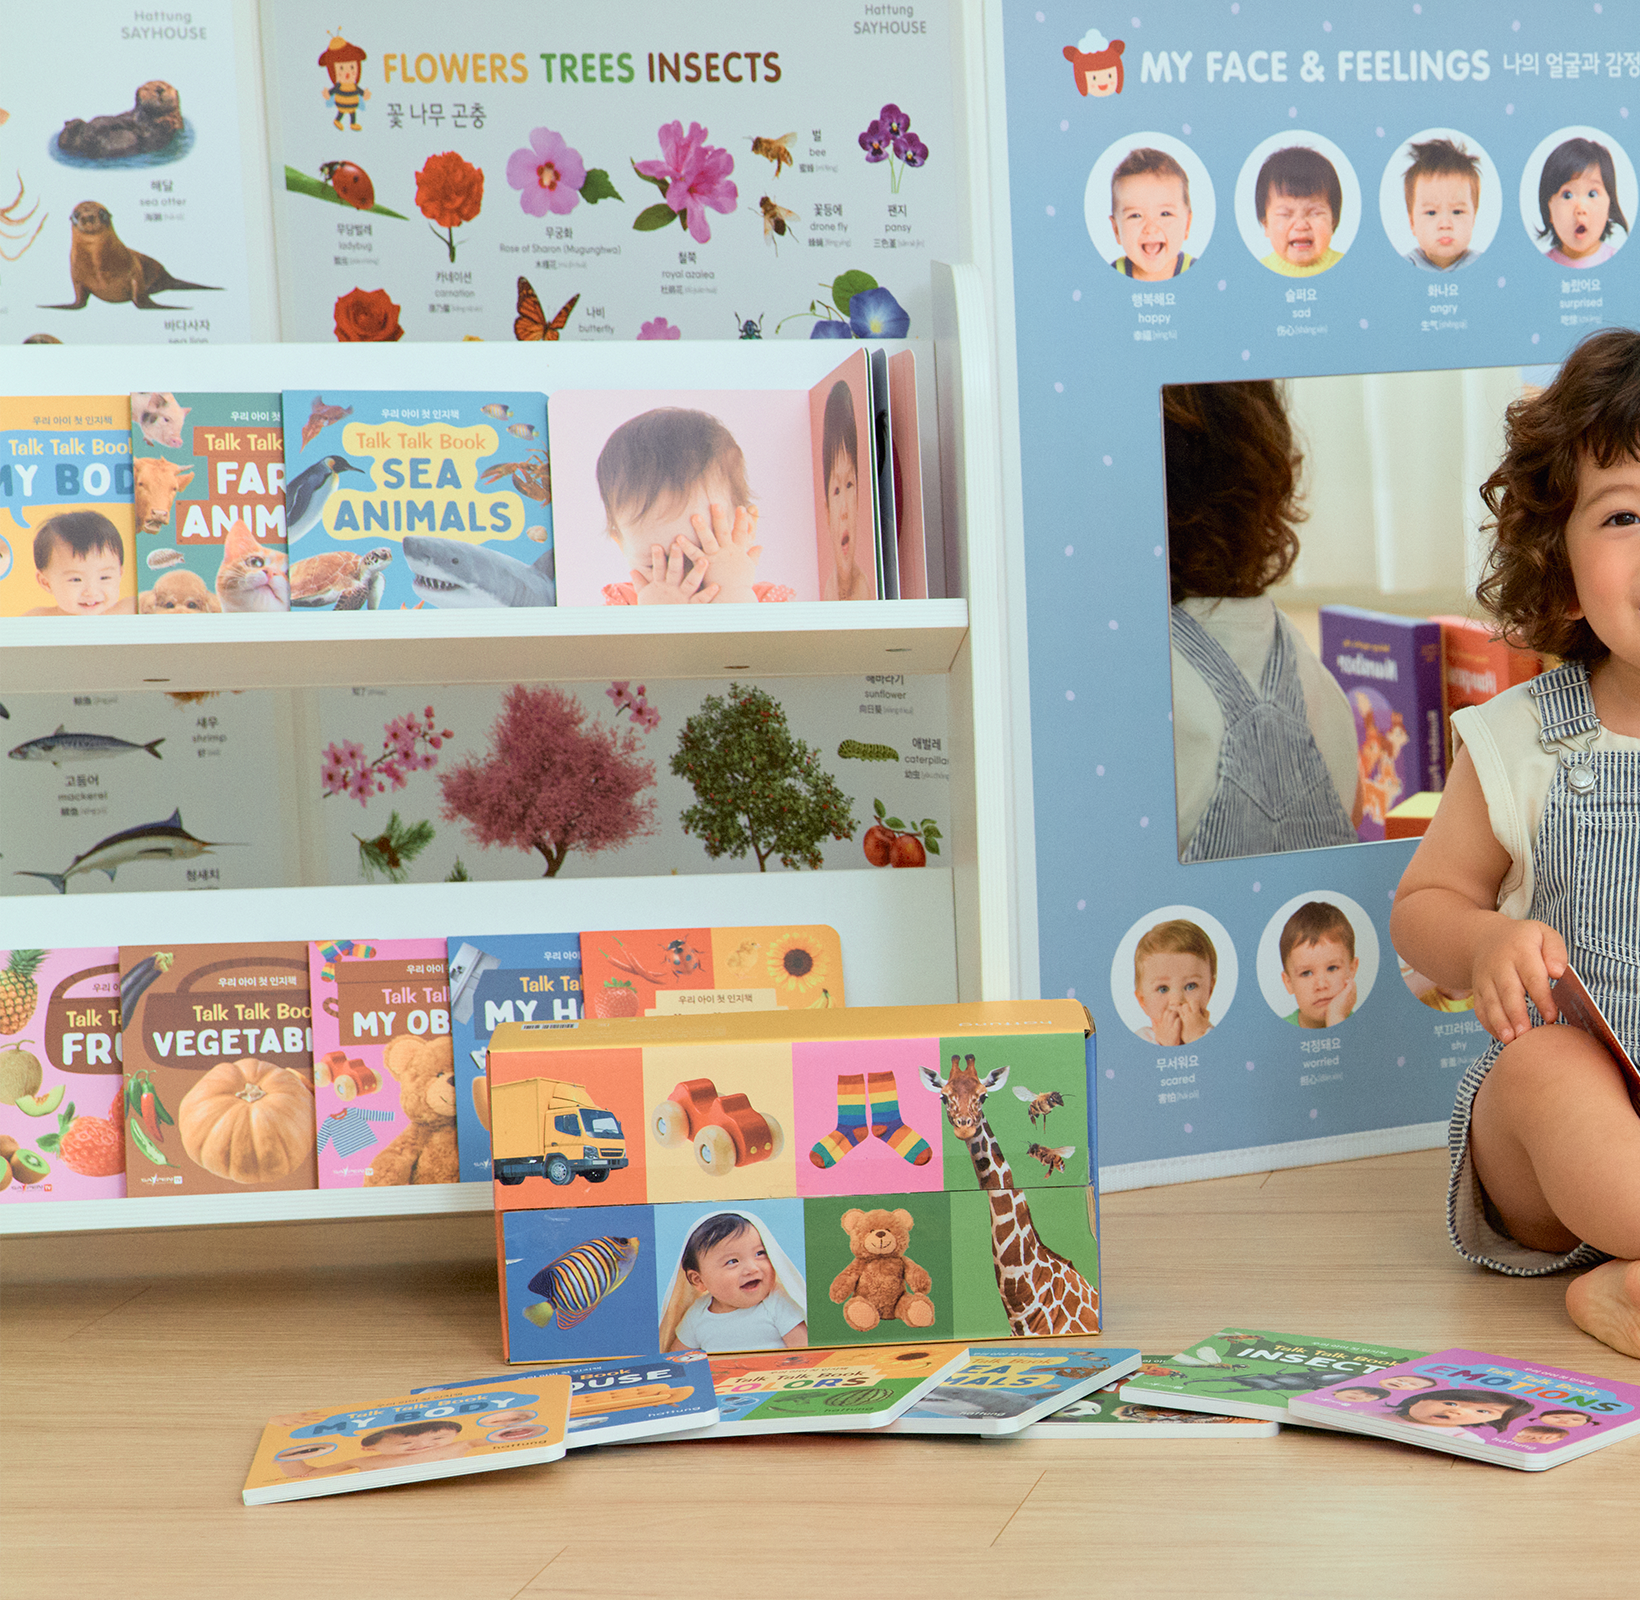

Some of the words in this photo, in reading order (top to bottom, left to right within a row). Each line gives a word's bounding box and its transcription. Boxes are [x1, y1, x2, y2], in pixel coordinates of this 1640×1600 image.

[133, 11, 193, 25] Hattung
[864, 4, 915, 18] Hattung
[120, 27, 207, 40] SAYHOUSE
[853, 21, 927, 34] SAYHOUSE
[384, 53, 528, 83] FLOWERS
[540, 53, 634, 83] TREES
[648, 52, 781, 83] INSECTS
[1141, 51, 1192, 83] MY
[1207, 51, 1287, 82] FACE
[1300, 50, 1325, 82] &
[1338, 49, 1490, 81] FEELINGS
[1503, 53, 1539, 75] 나의
[1546, 52, 1600, 78] 얼굴과
[1605, 52, 1640, 77] 감정
[388, 103, 404, 128] 꽃
[410, 103, 445, 126] 나무
[452, 103, 486, 129] 곤충
[150, 180, 174, 192] 해달
[887, 205, 907, 217] 팬지
[338, 241, 374, 252] ladybug
[435, 271, 472, 284] 카네이션
[1284, 289, 1318, 302] 슬퍼요
[1427, 284, 1459, 297] 화나요
[1131, 293, 1176, 307] 행복해요
[1559, 297, 1604, 309] surprised
[1292, 308, 1312, 318] sad
[1429, 305, 1459, 315] angry
[1137, 313, 1172, 324] happy
[8, 438, 44, 455] Talk
[49, 438, 85, 455] Talk
[203, 433, 241, 450] Talk
[247, 434, 282, 452] Talk
[355, 432, 391, 448] Talk
[396, 432, 433, 449] Talk
[439, 433, 486, 449] Book
[382, 458, 462, 489] SEA
[182, 505, 287, 538] ANIM
[334, 500, 511, 532] ANIMALS
[196, 717, 218, 728] 새우
[911, 738, 942, 750] 애벌레
[65, 775, 100, 787] 고등어
[186, 869, 220, 881] 청새치
[519, 975, 555, 992] Talk
[381, 987, 417, 1004] Talk
[65, 1009, 102, 1027] Talk
[192, 1004, 229, 1022] Talk
[233, 1003, 271, 1020] Talk
[485, 999, 537, 1032] MY
[353, 1012, 396, 1037] MY
[1299, 1038, 1341, 1053] 걱정돼요
[1155, 1055, 1200, 1071] 무서워요
[1301, 1056, 1340, 1068] worried
[1160, 1074, 1196, 1086] scared
[1273, 1345, 1305, 1355] Talk
[1313, 1350, 1349, 1360] Talk
[1237, 1348, 1388, 1374] INSECT
[580, 1369, 630, 1379] Book
[1485, 1367, 1516, 1378] Talk
[1518, 1375, 1555, 1387] Talk
[1558, 1383, 1601, 1396] Book
[714, 1376, 869, 1394] COLORS
[1422, 1364, 1622, 1413] EMOTIONS
[394, 1403, 431, 1413] Talk
[438, 1395, 489, 1406] Book
[647, 1406, 702, 1417] hattung
[313, 1418, 373, 1435] MY
[395, 1398, 515, 1422] BODY
[492, 1440, 548, 1450] hattung
[1490, 1436, 1538, 1451] hattung
